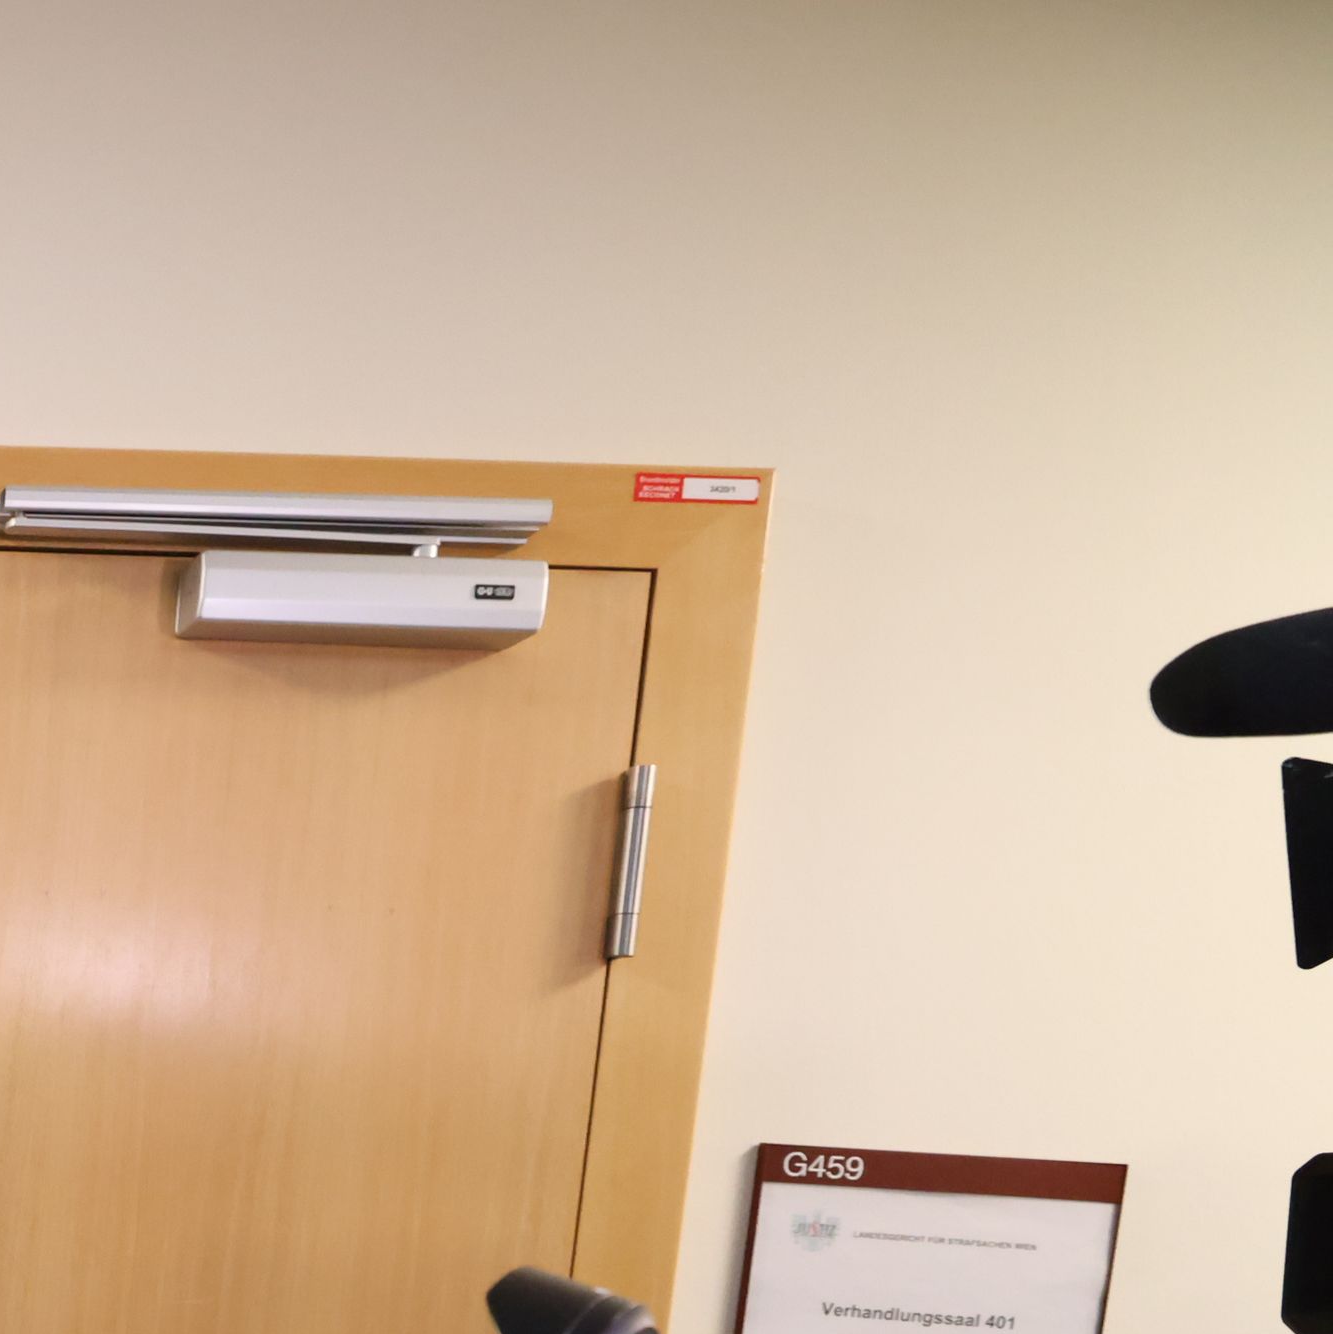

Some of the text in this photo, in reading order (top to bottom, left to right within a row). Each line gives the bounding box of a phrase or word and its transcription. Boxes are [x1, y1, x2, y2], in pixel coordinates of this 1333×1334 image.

[783, 1151, 865, 1181] G459
[948, 1237, 1012, 1249] STRAFSACHEN
[821, 1301, 1016, 1330] Verhandlungssaal 401
